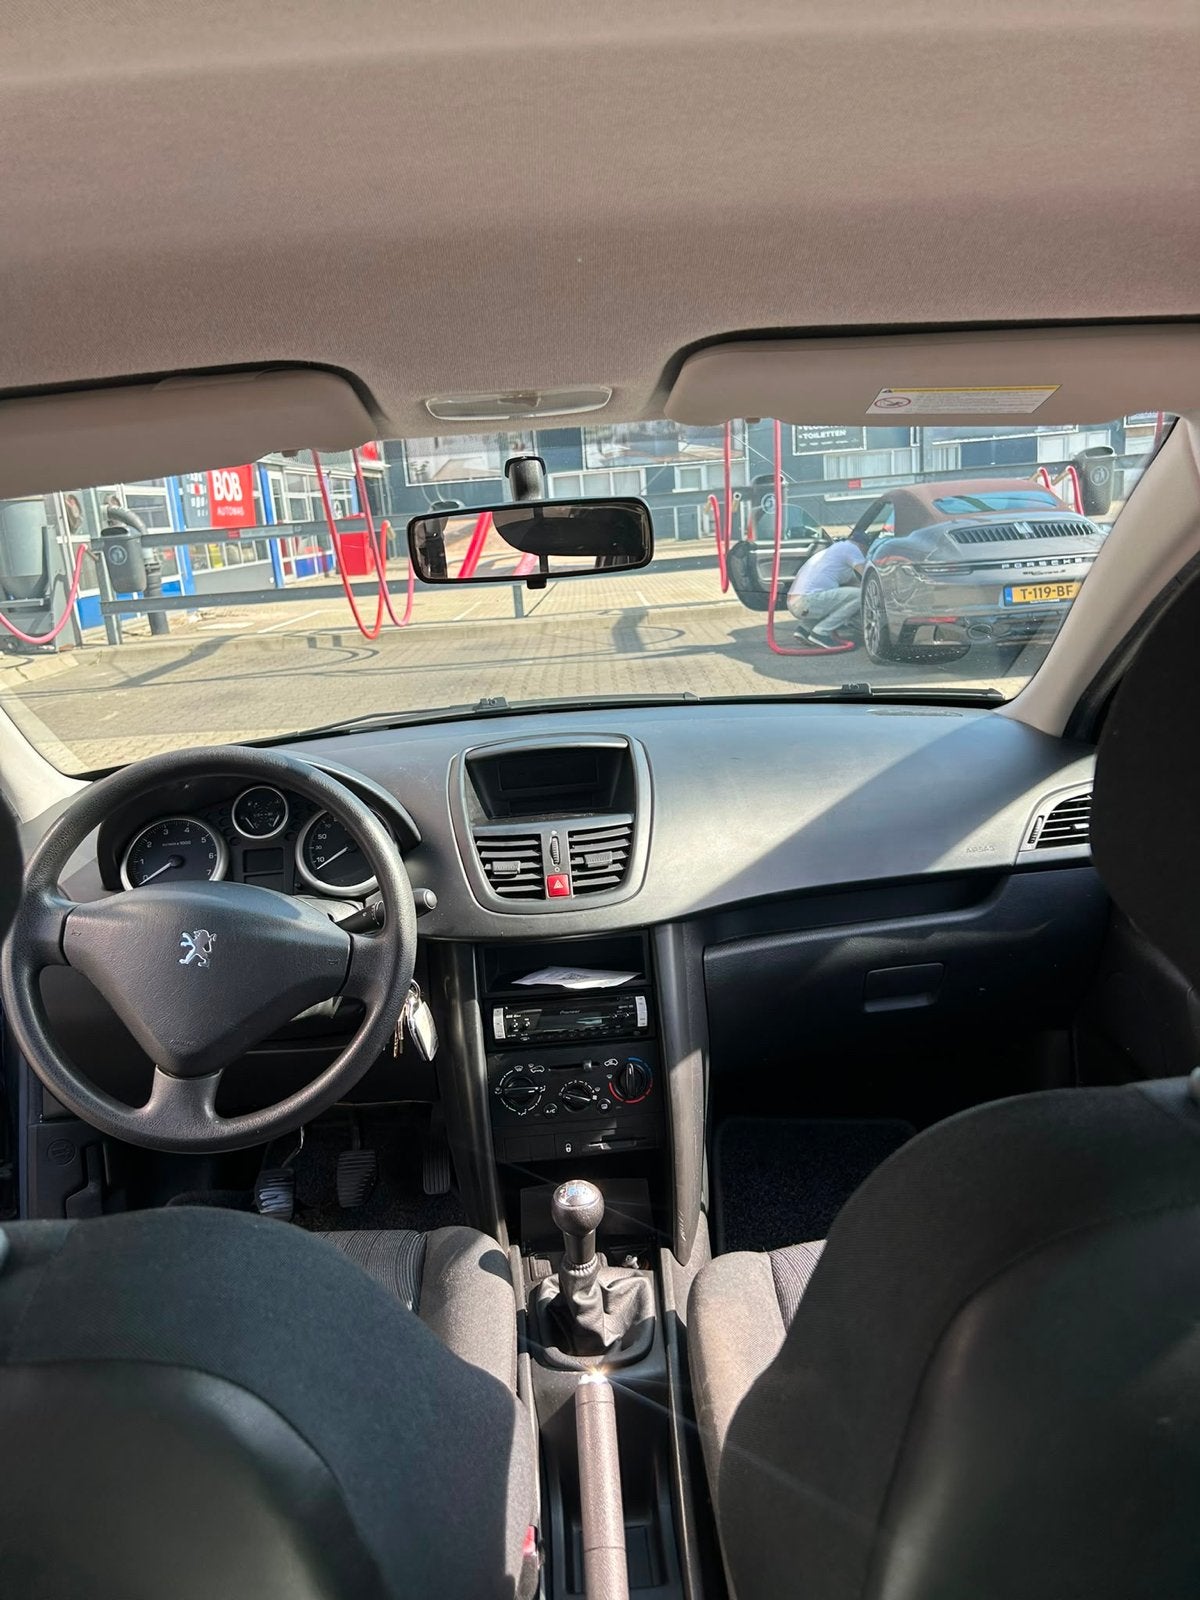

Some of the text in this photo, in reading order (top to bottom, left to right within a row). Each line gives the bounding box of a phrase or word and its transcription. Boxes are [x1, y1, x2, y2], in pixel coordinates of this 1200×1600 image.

[802, 430, 846, 439] TOILETTEN
[211, 470, 242, 501] BOB
[1001, 557, 1083, 569] PORSCHE
[1020, 585, 1073, 600] T-119-BF
[201, 836, 207, 844] 5
